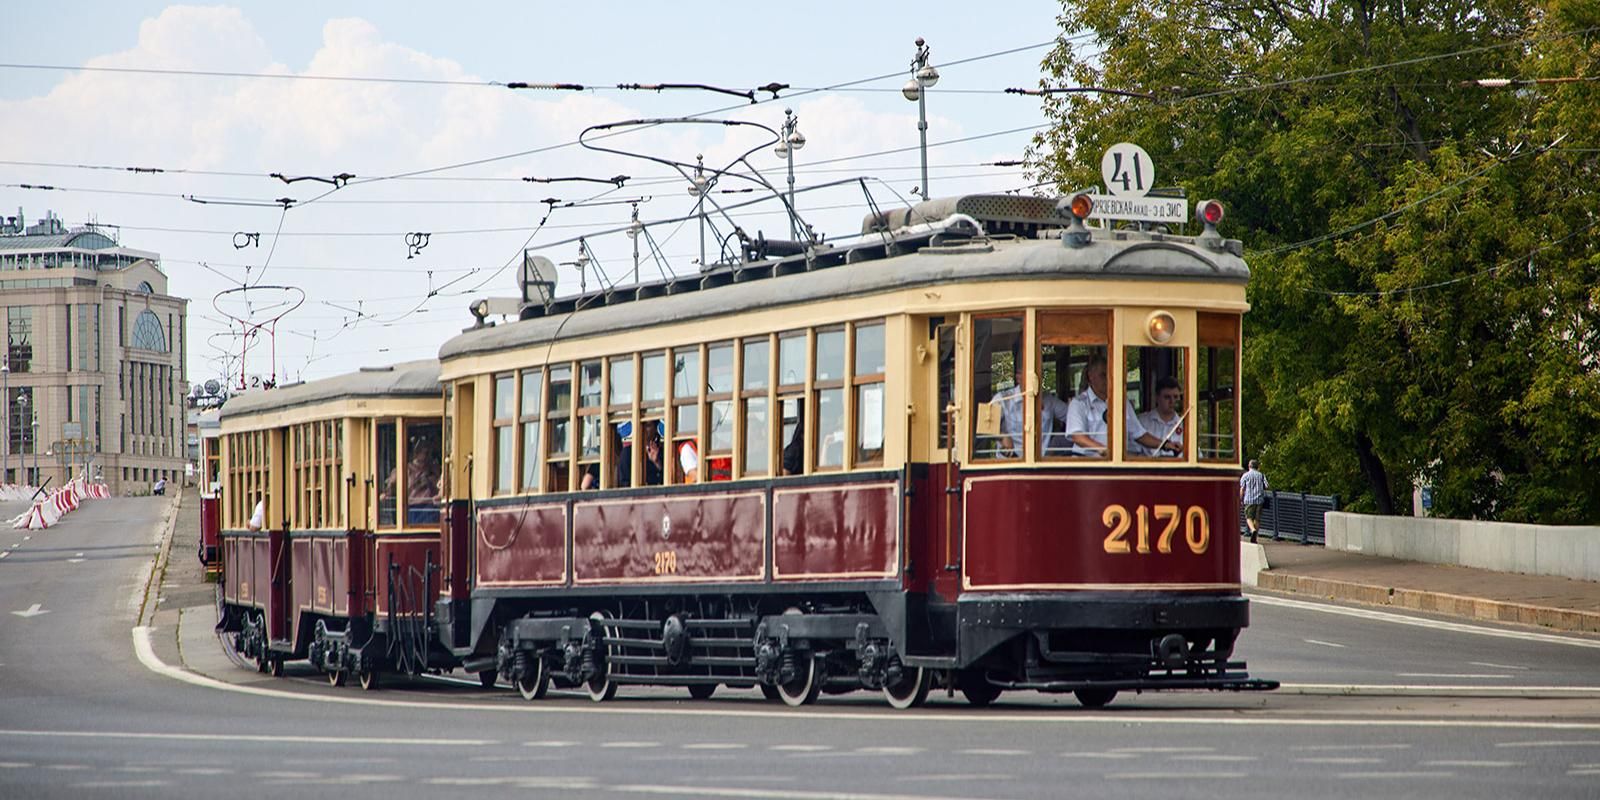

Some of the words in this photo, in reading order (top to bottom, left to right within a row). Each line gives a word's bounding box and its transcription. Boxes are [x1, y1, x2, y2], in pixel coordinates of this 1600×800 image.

[1111, 152, 1144, 191] 41
[1166, 202, 1182, 218] ЗИС
[1102, 504, 1210, 554] 2170
[655, 551, 677, 574] 2170
